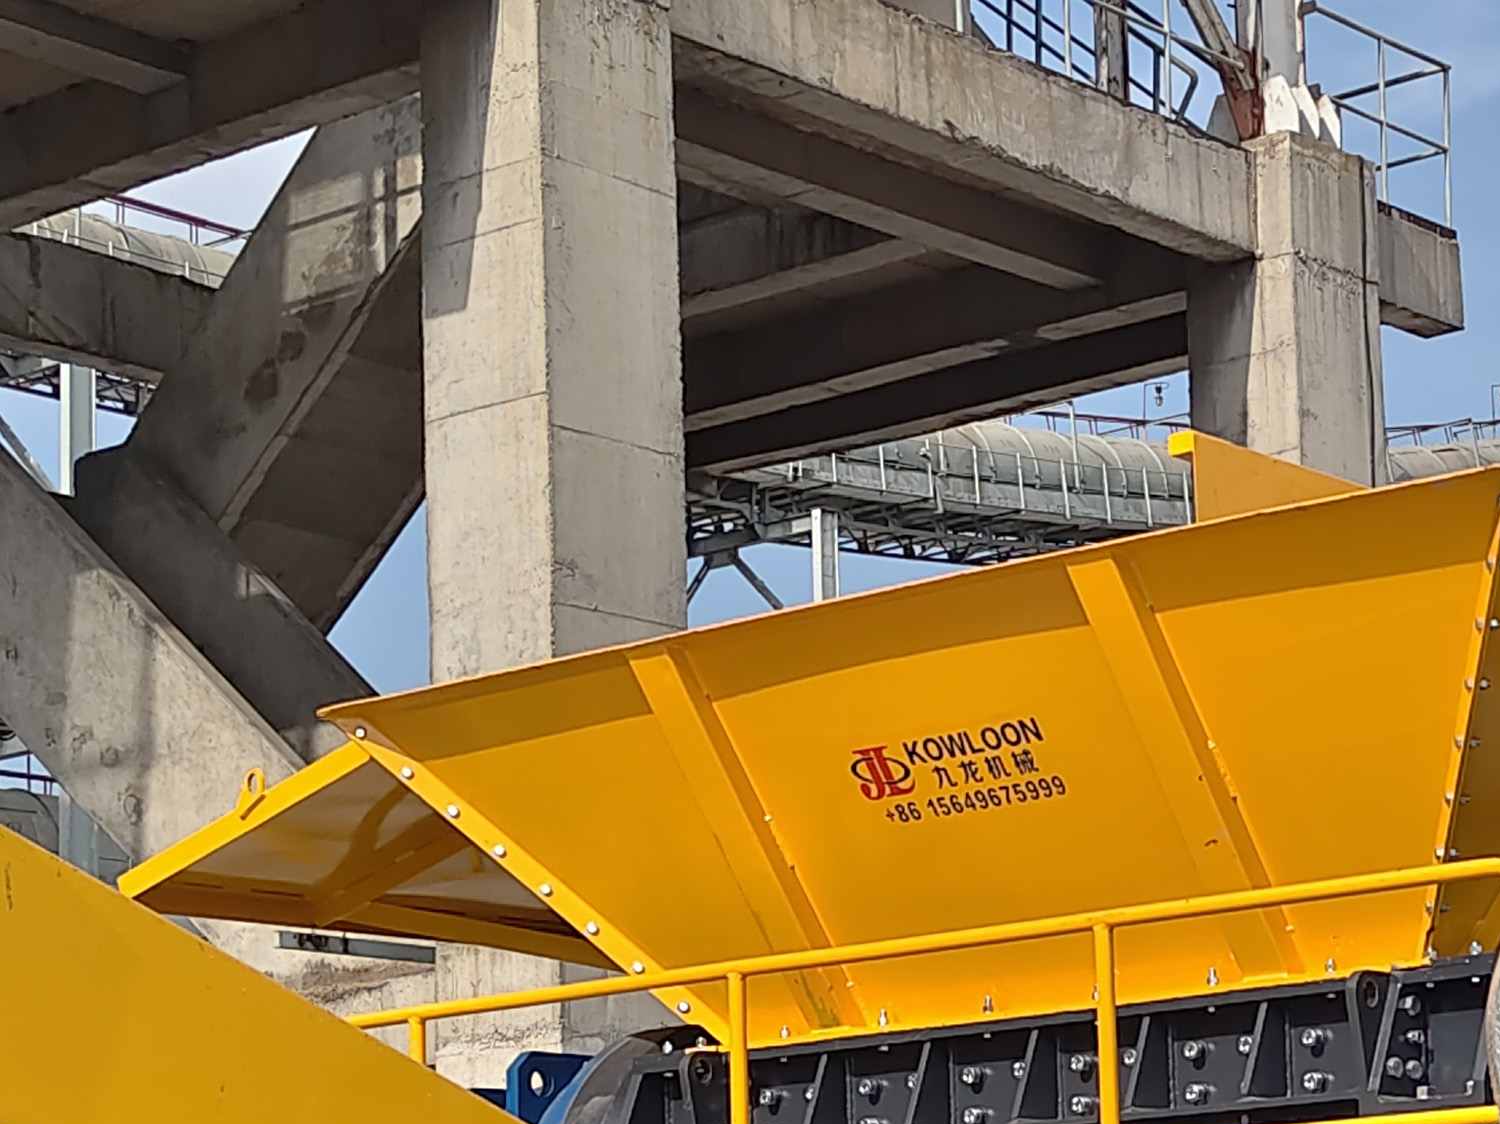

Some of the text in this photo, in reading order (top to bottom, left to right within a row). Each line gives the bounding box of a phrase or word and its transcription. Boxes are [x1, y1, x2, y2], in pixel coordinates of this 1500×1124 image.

[902, 717, 1044, 765] KOWLOON
[931, 749, 1040, 789] 九龙机械
[885, 775, 1067, 823] +86 15649675999
